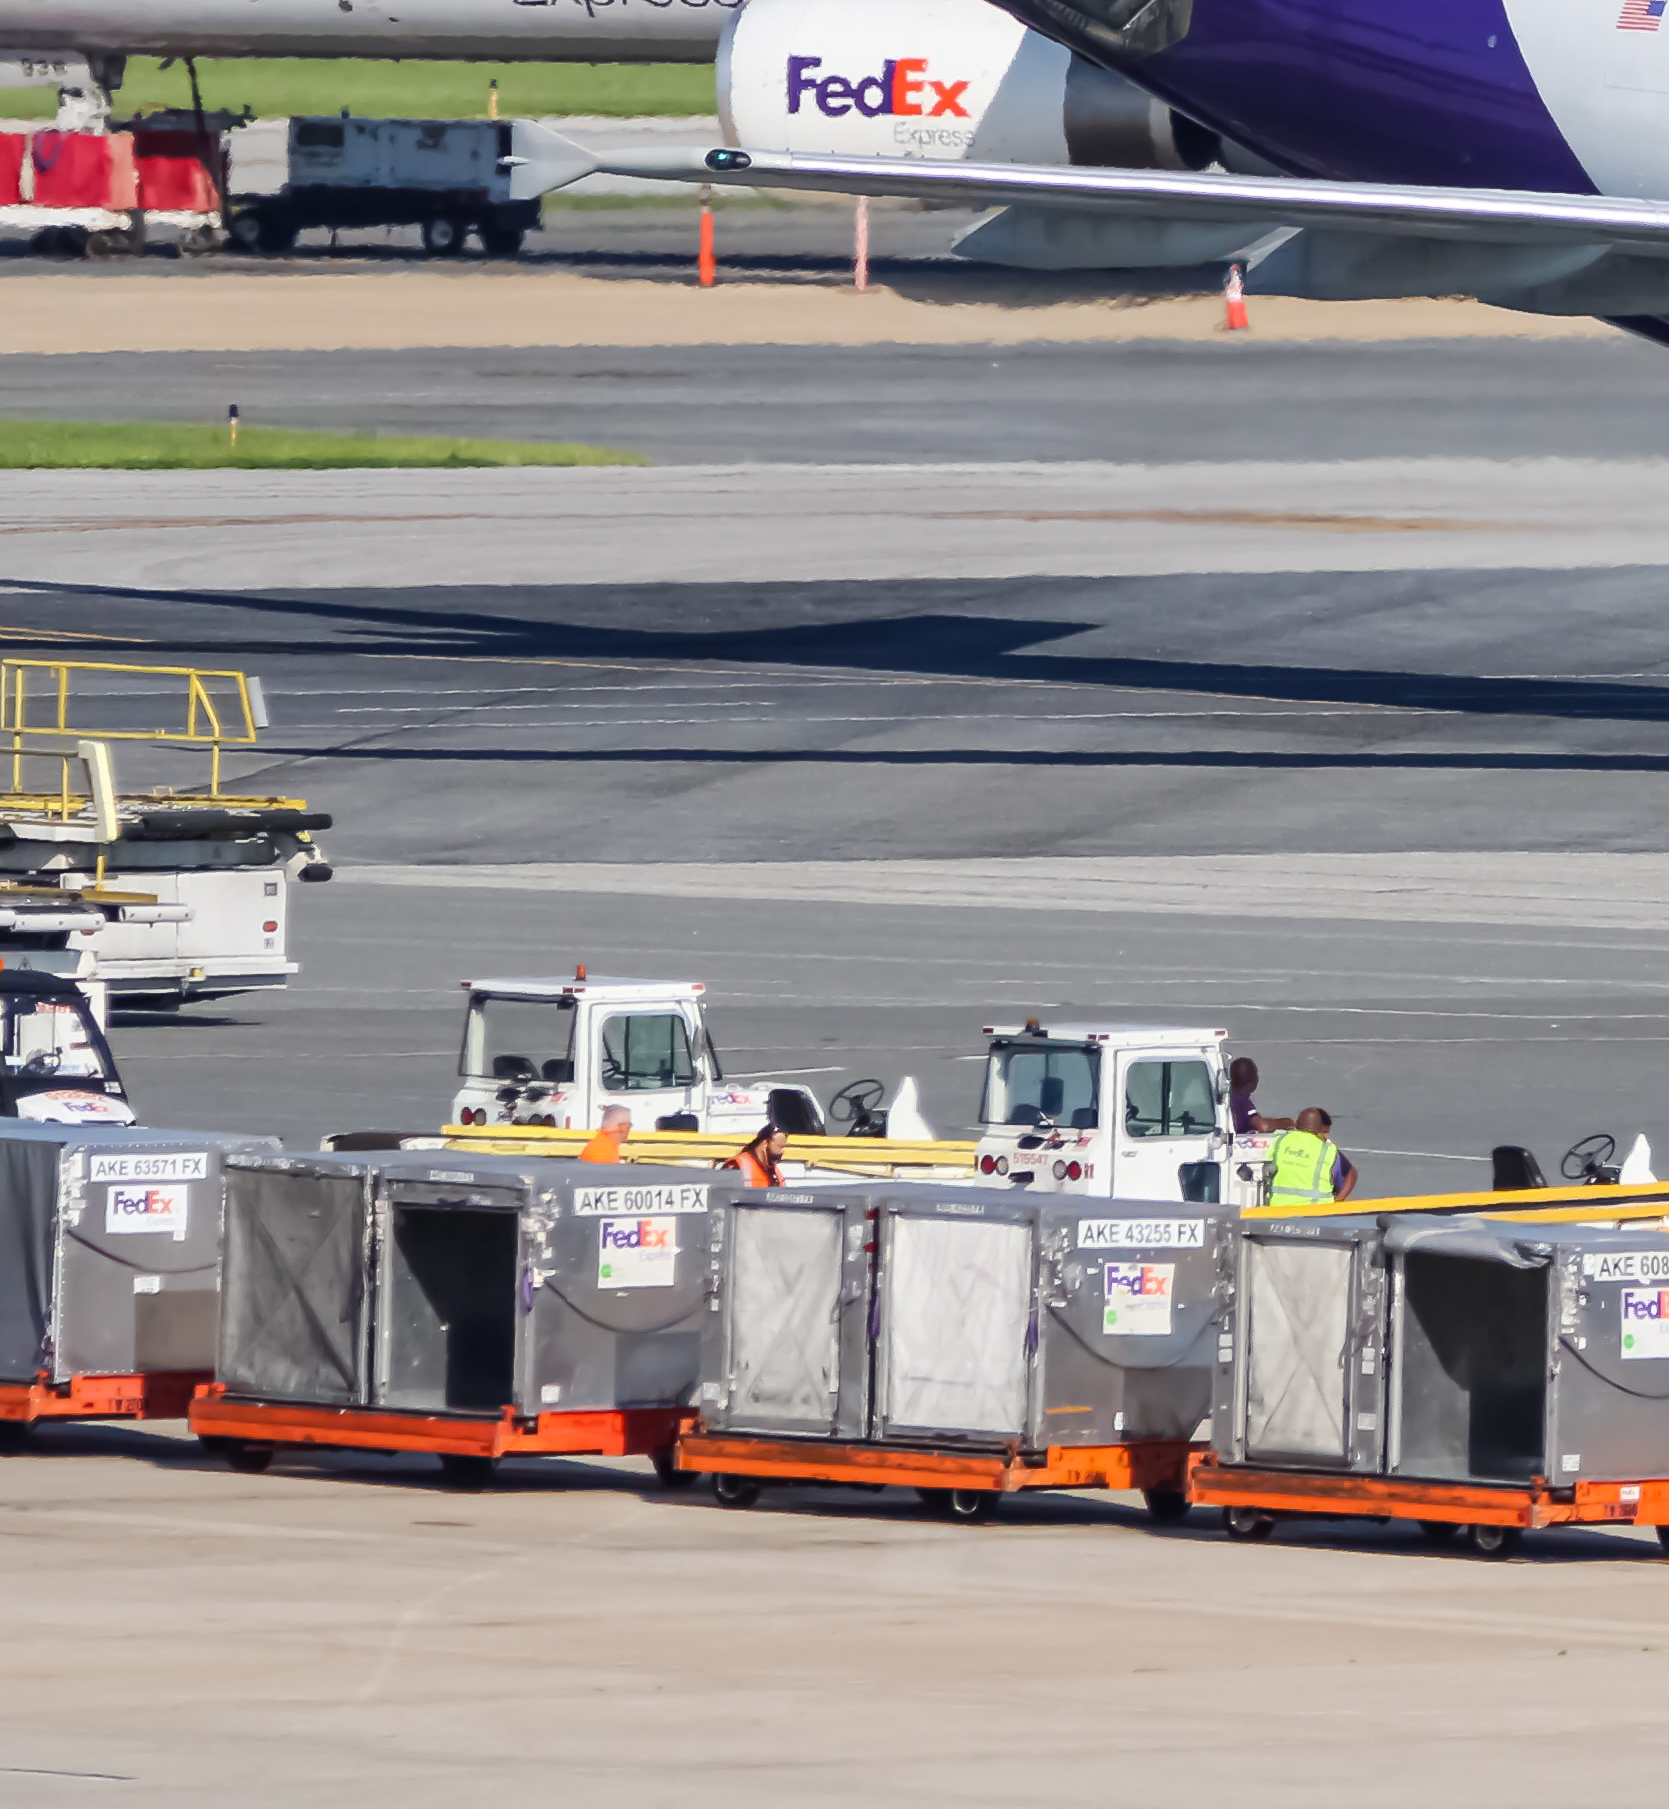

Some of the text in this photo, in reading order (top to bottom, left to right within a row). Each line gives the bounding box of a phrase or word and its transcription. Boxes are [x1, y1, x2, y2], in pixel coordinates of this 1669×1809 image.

[787, 55, 972, 118] FedEx
[893, 121, 976, 148] Express
[95, 1158, 202, 1176] AKE 63571 FX
[113, 1190, 174, 1215] FedEx
[580, 1187, 705, 1211] AKE 60014 FX
[601, 1220, 669, 1249] FedEx
[1083, 1223, 1198, 1244] AKE 43255 FX
[1599, 1256, 1635, 1277] AKE
[1107, 1266, 1169, 1295] FedEx
